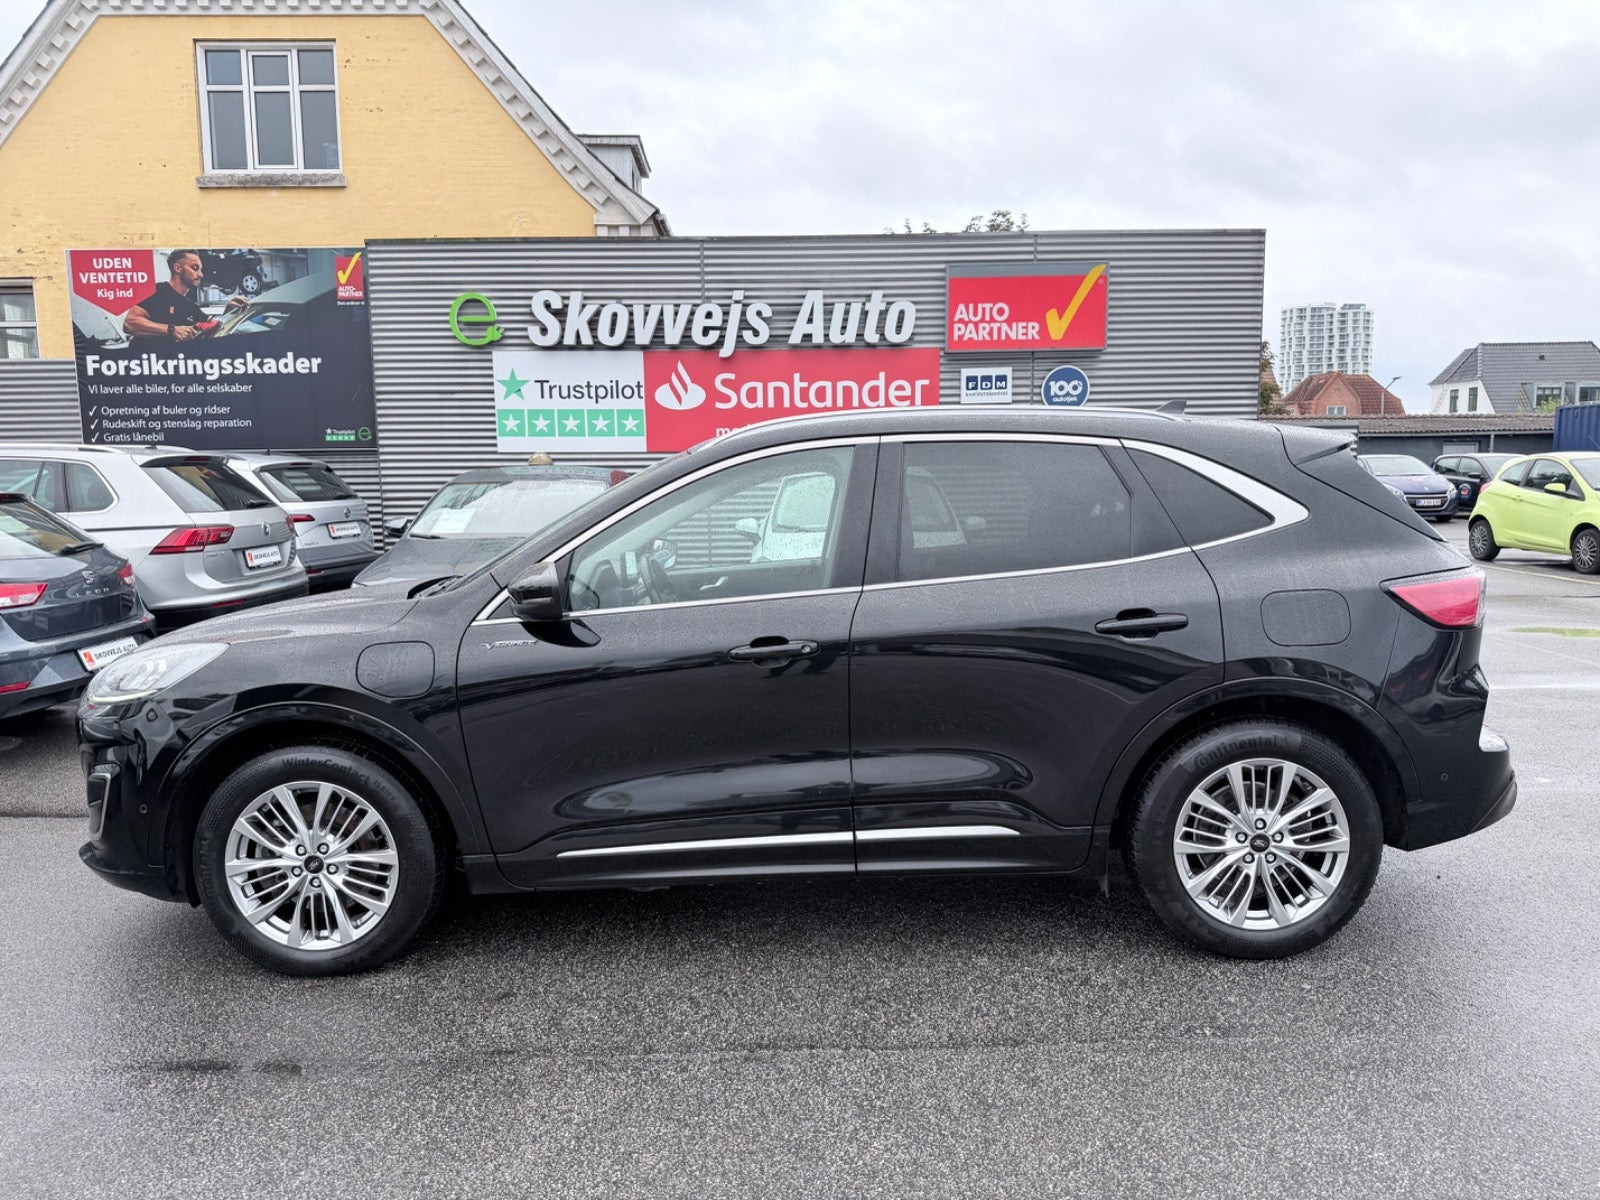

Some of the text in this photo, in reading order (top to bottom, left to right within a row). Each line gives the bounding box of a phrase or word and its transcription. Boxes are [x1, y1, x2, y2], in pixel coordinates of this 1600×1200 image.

[92, 257, 132, 269] UDEN
[79, 271, 148, 284] VENTETID
[97, 287, 133, 300] Kig ind
[953, 302, 1010, 322] AUTO
[527, 289, 917, 358] Skovvejs Auto
[953, 321, 1040, 341] PARTNER
[85, 352, 322, 380] Forsikringsskader
[88, 382, 253, 395] Vi laver alle biler, for alle selskaber
[714, 371, 930, 410] Santander
[967, 378, 1007, 390] FDM
[534, 380, 644, 404] Trustpilot
[101, 404, 231, 417] Opretning af buler og ridser
[102, 417, 252, 430] Rudeskift og stenslag reparation
[103, 431, 165, 442] Gratis lånebil
